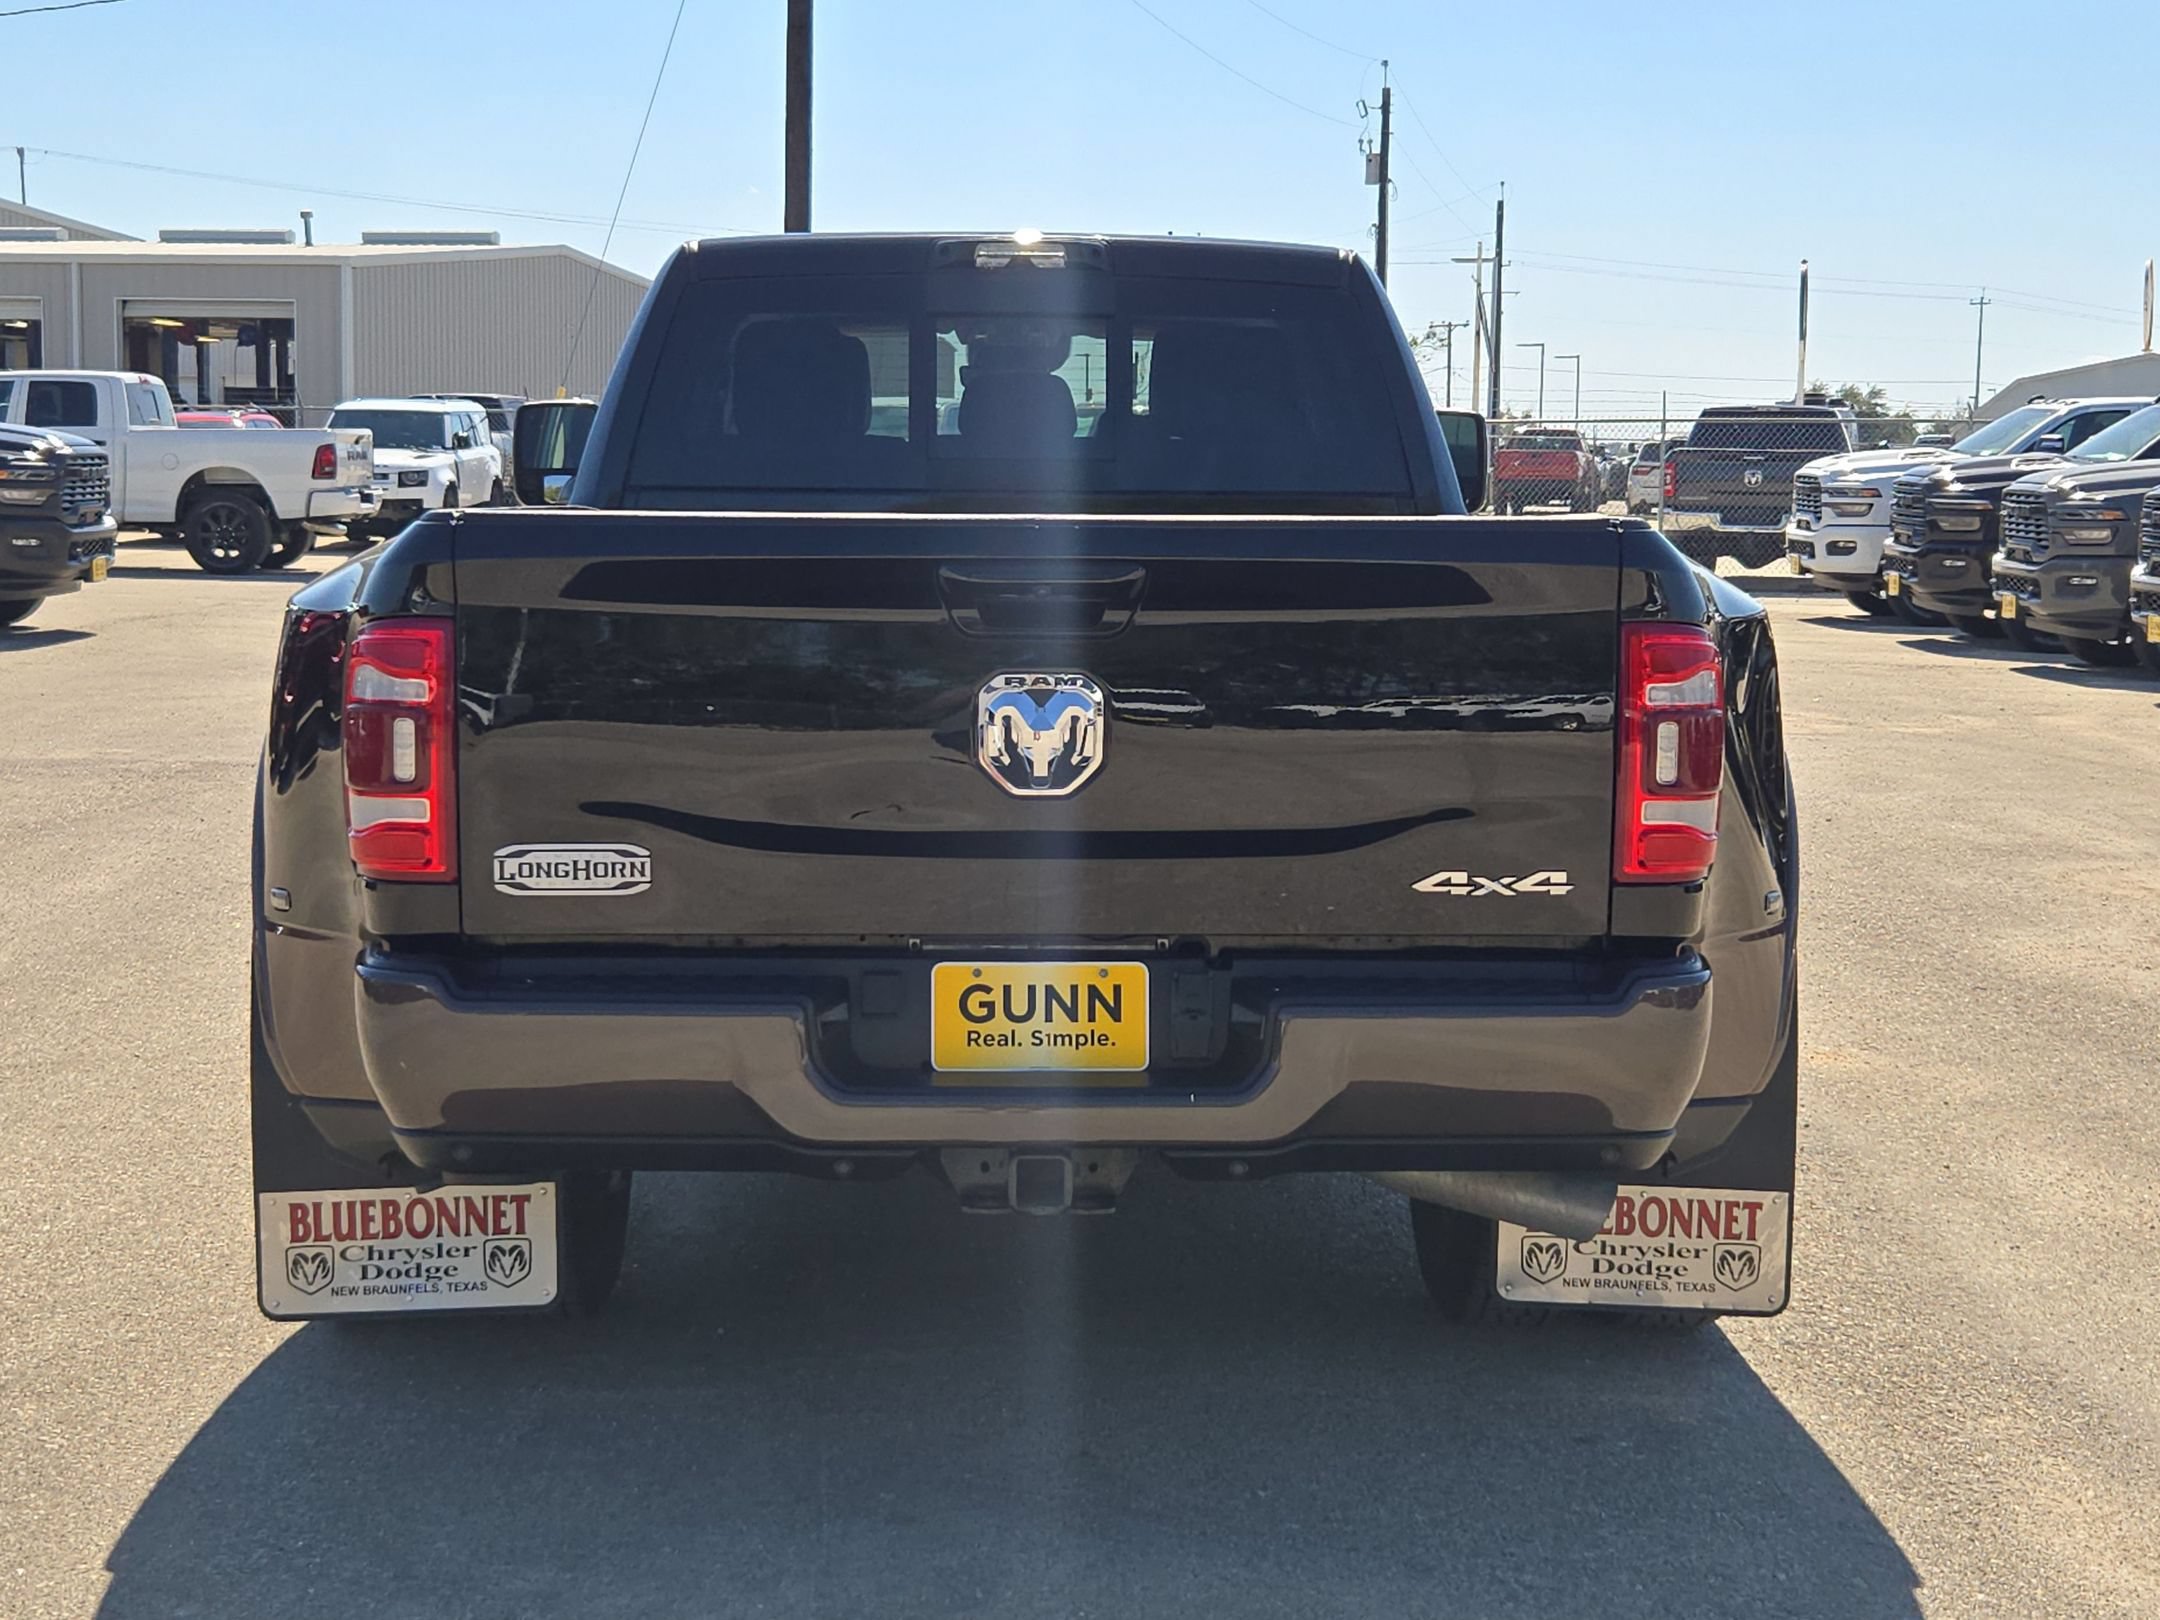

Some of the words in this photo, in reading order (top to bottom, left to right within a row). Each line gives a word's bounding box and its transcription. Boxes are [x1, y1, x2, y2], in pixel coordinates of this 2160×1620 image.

[958, 983, 1123, 1024] GUNN
[966, 1029, 1023, 1048] Real.
[1031, 1029, 1117, 1050] Simple.
[288, 1194, 532, 1244] BLUEBONNET
[1598, 1194, 1764, 1242] BONNET
[339, 1241, 479, 1263] Chrysler
[1572, 1238, 1709, 1260] Chrysler
[360, 1262, 460, 1282] Dodge
[1592, 1257, 1689, 1280] Dodge
[331, 1285, 360, 1298] NEW
[363, 1283, 443, 1297] BRAUNFELS,
[447, 1280, 488, 1293] TEXAS
[1562, 1276, 1591, 1289] NEW
[1594, 1278, 1672, 1292] BRAUNFELS,
[1675, 1281, 1716, 1294] TEXAS
